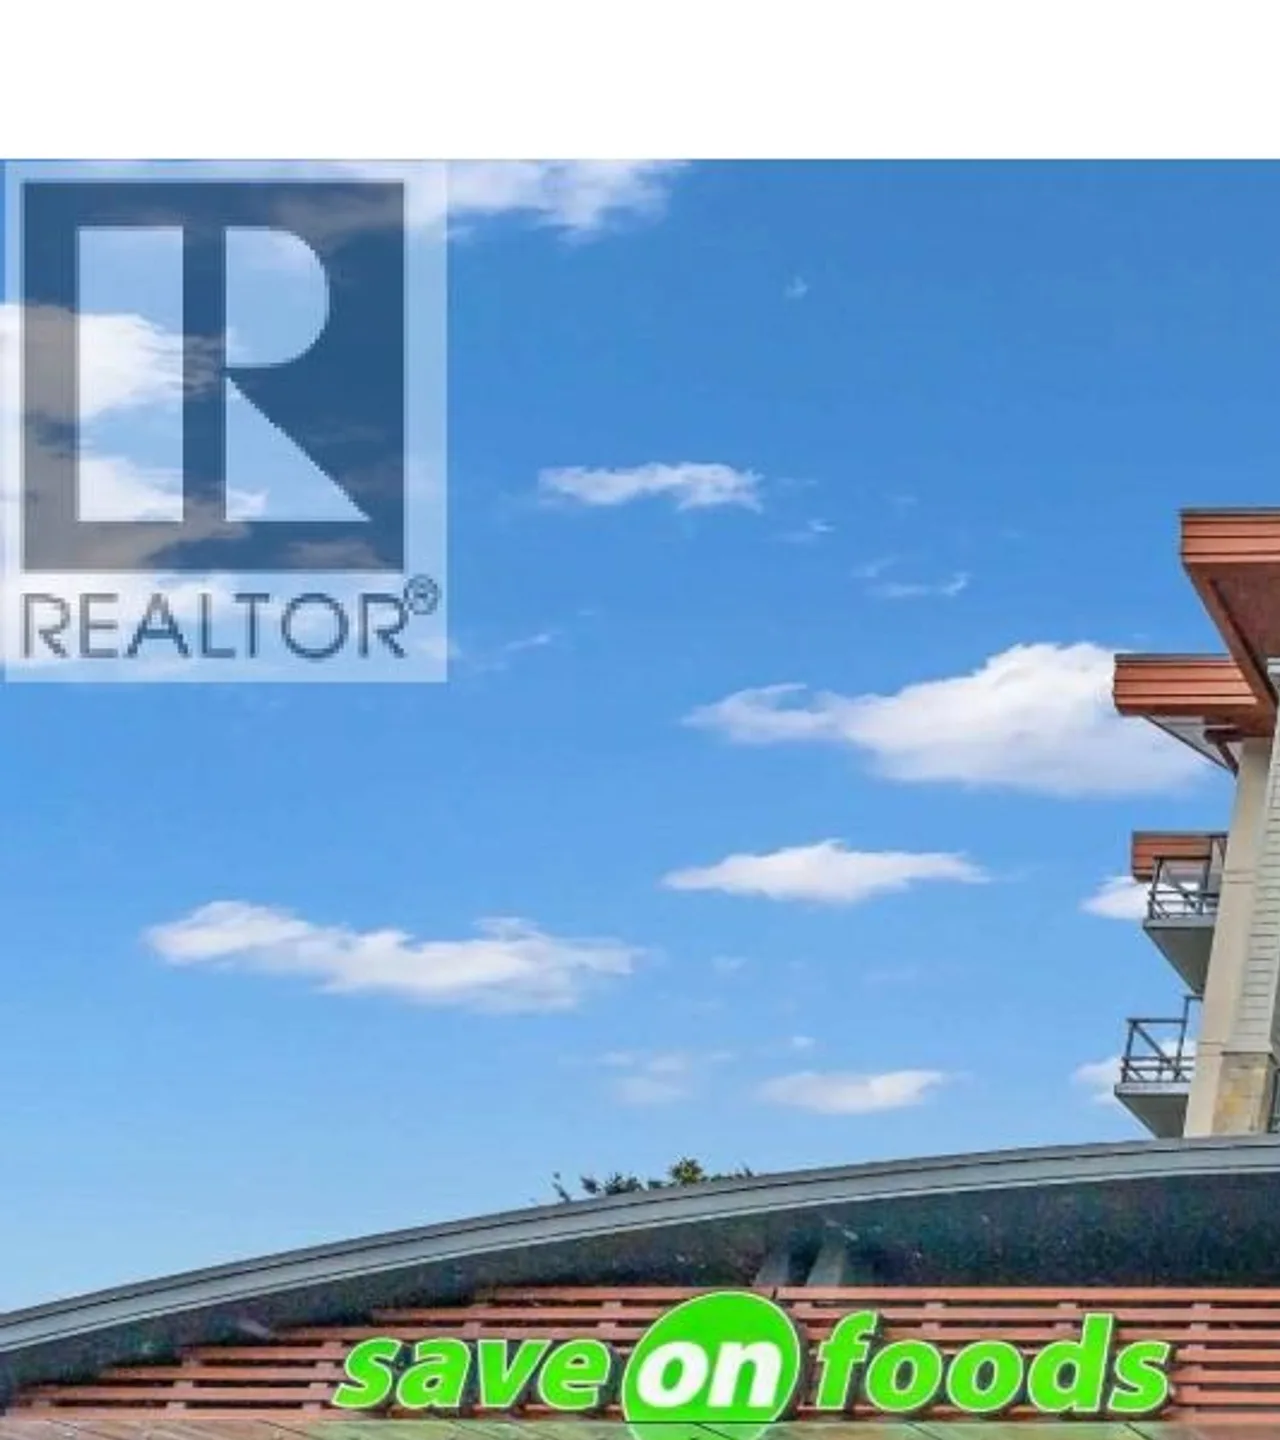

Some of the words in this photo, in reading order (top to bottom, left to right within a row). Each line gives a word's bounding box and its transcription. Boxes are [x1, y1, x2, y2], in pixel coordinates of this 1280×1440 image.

[330, 1335, 612, 1411] save
[635, 1337, 783, 1410] on
[815, 1311, 1172, 1414] foods
